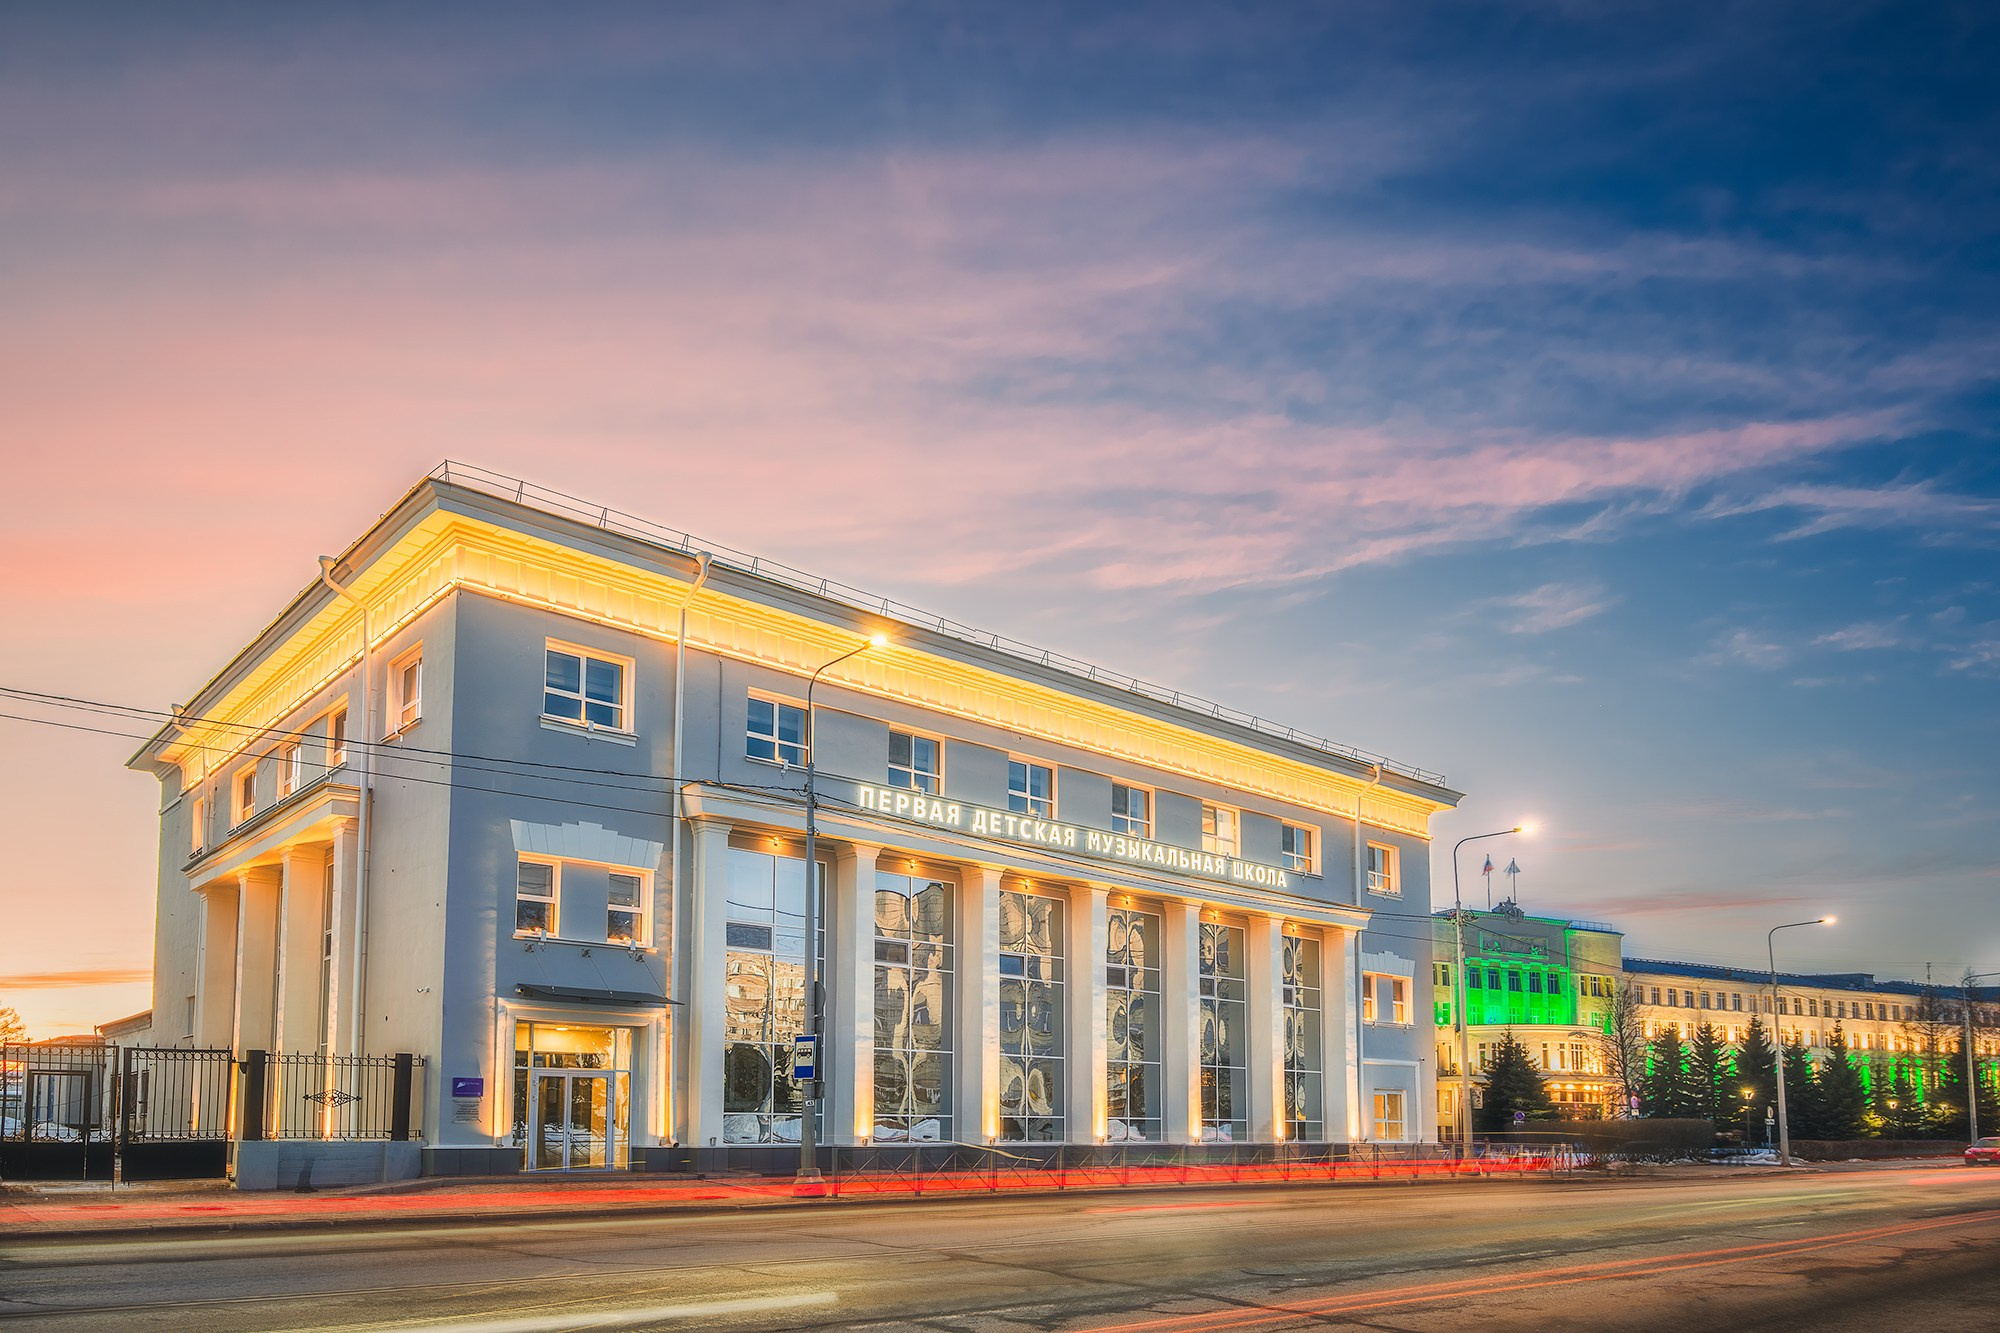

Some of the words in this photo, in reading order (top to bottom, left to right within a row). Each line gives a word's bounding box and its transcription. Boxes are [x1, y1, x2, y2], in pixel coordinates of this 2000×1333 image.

[860, 786, 960, 825] ПЕРВАЯ
[972, 809, 1075, 847] ДЕТСКАЯ
[1088, 831, 1225, 875] МУЗЫКАЛЬНАЯ
[1232, 860, 1288, 888] ШКОЛА
